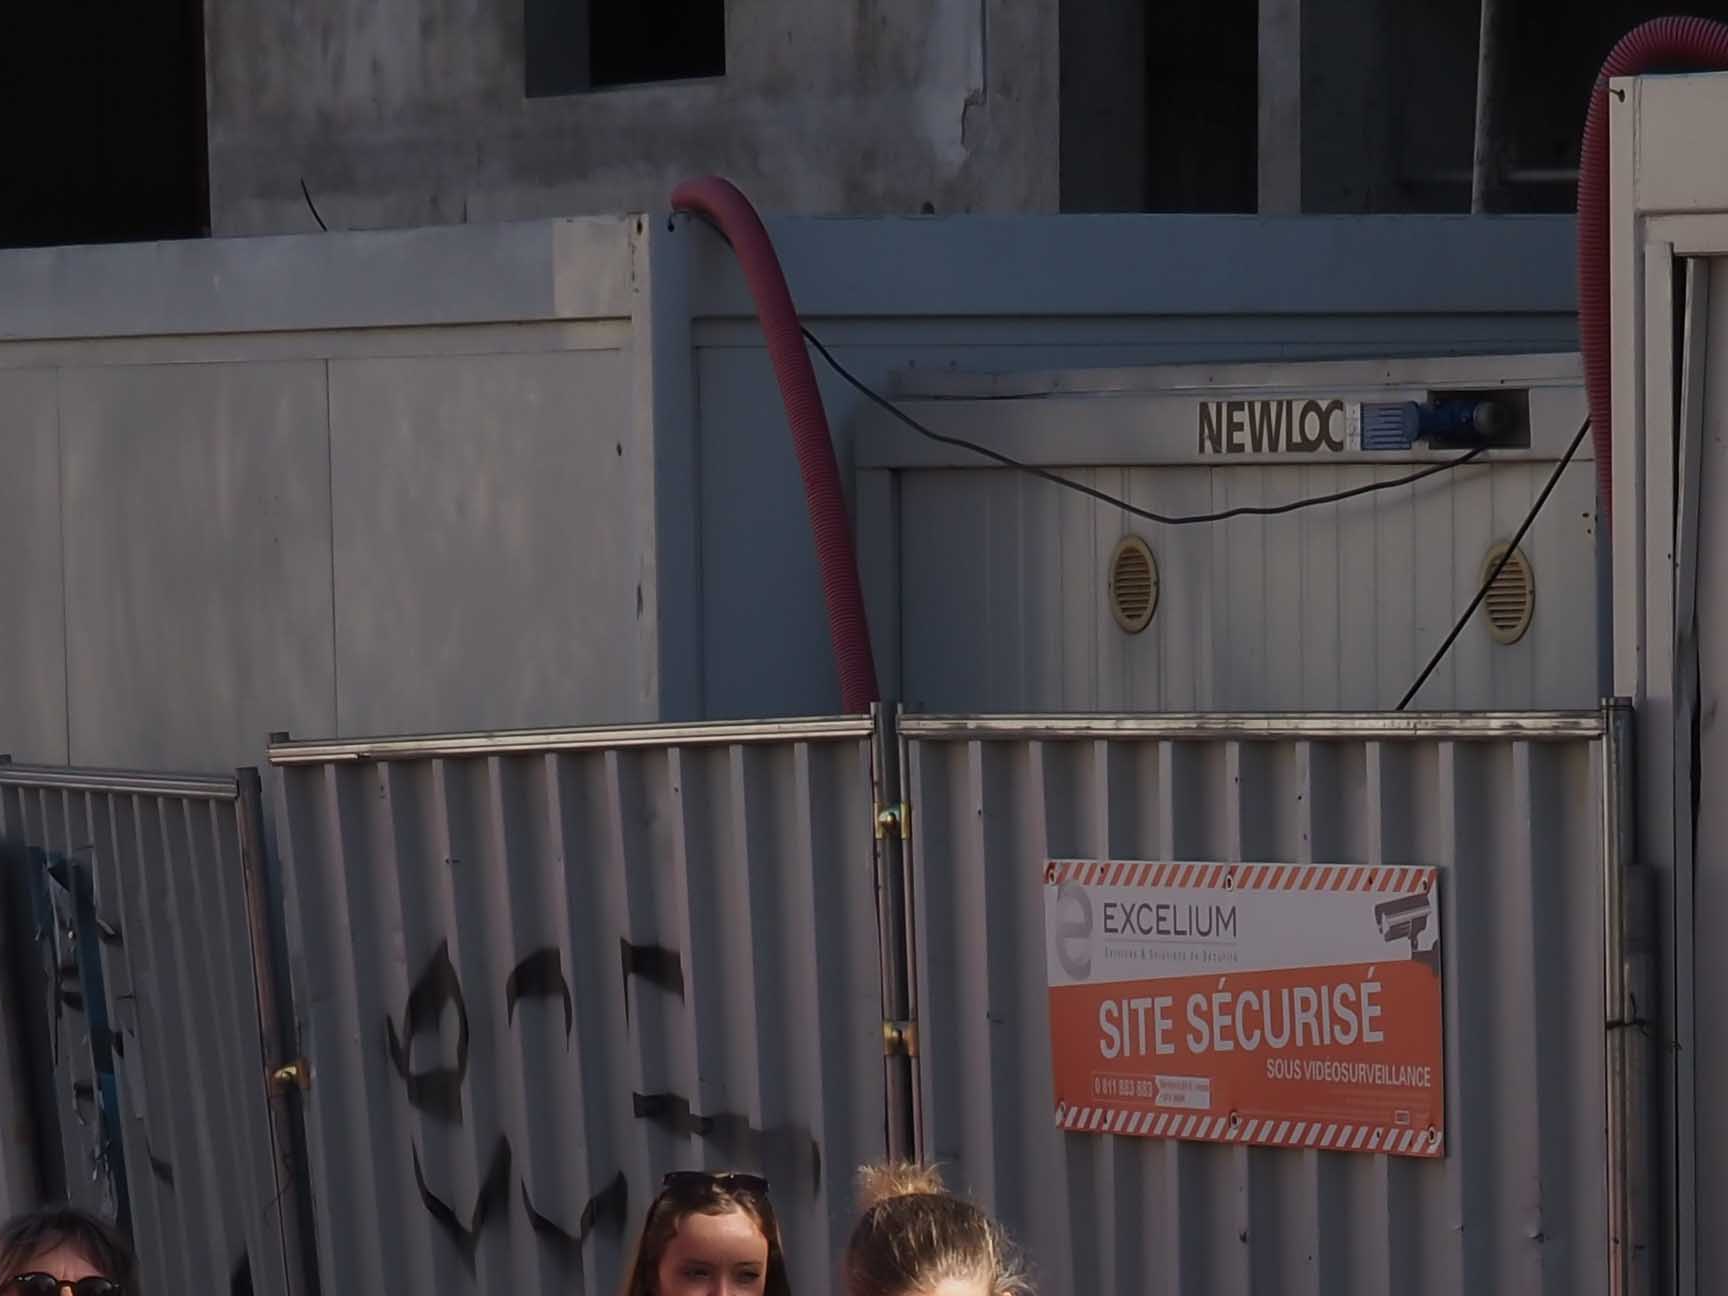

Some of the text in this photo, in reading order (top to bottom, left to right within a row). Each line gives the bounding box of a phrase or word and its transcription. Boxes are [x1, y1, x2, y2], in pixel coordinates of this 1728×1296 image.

[1198, 400, 1344, 453] NEWLOC
[1103, 902, 1238, 938] EXCELIUM
[1098, 967, 1385, 1059] SITE SÉCURISÉ
[1266, 1056, 1432, 1088] SOUS VIDÉOSURVEILLANCE
